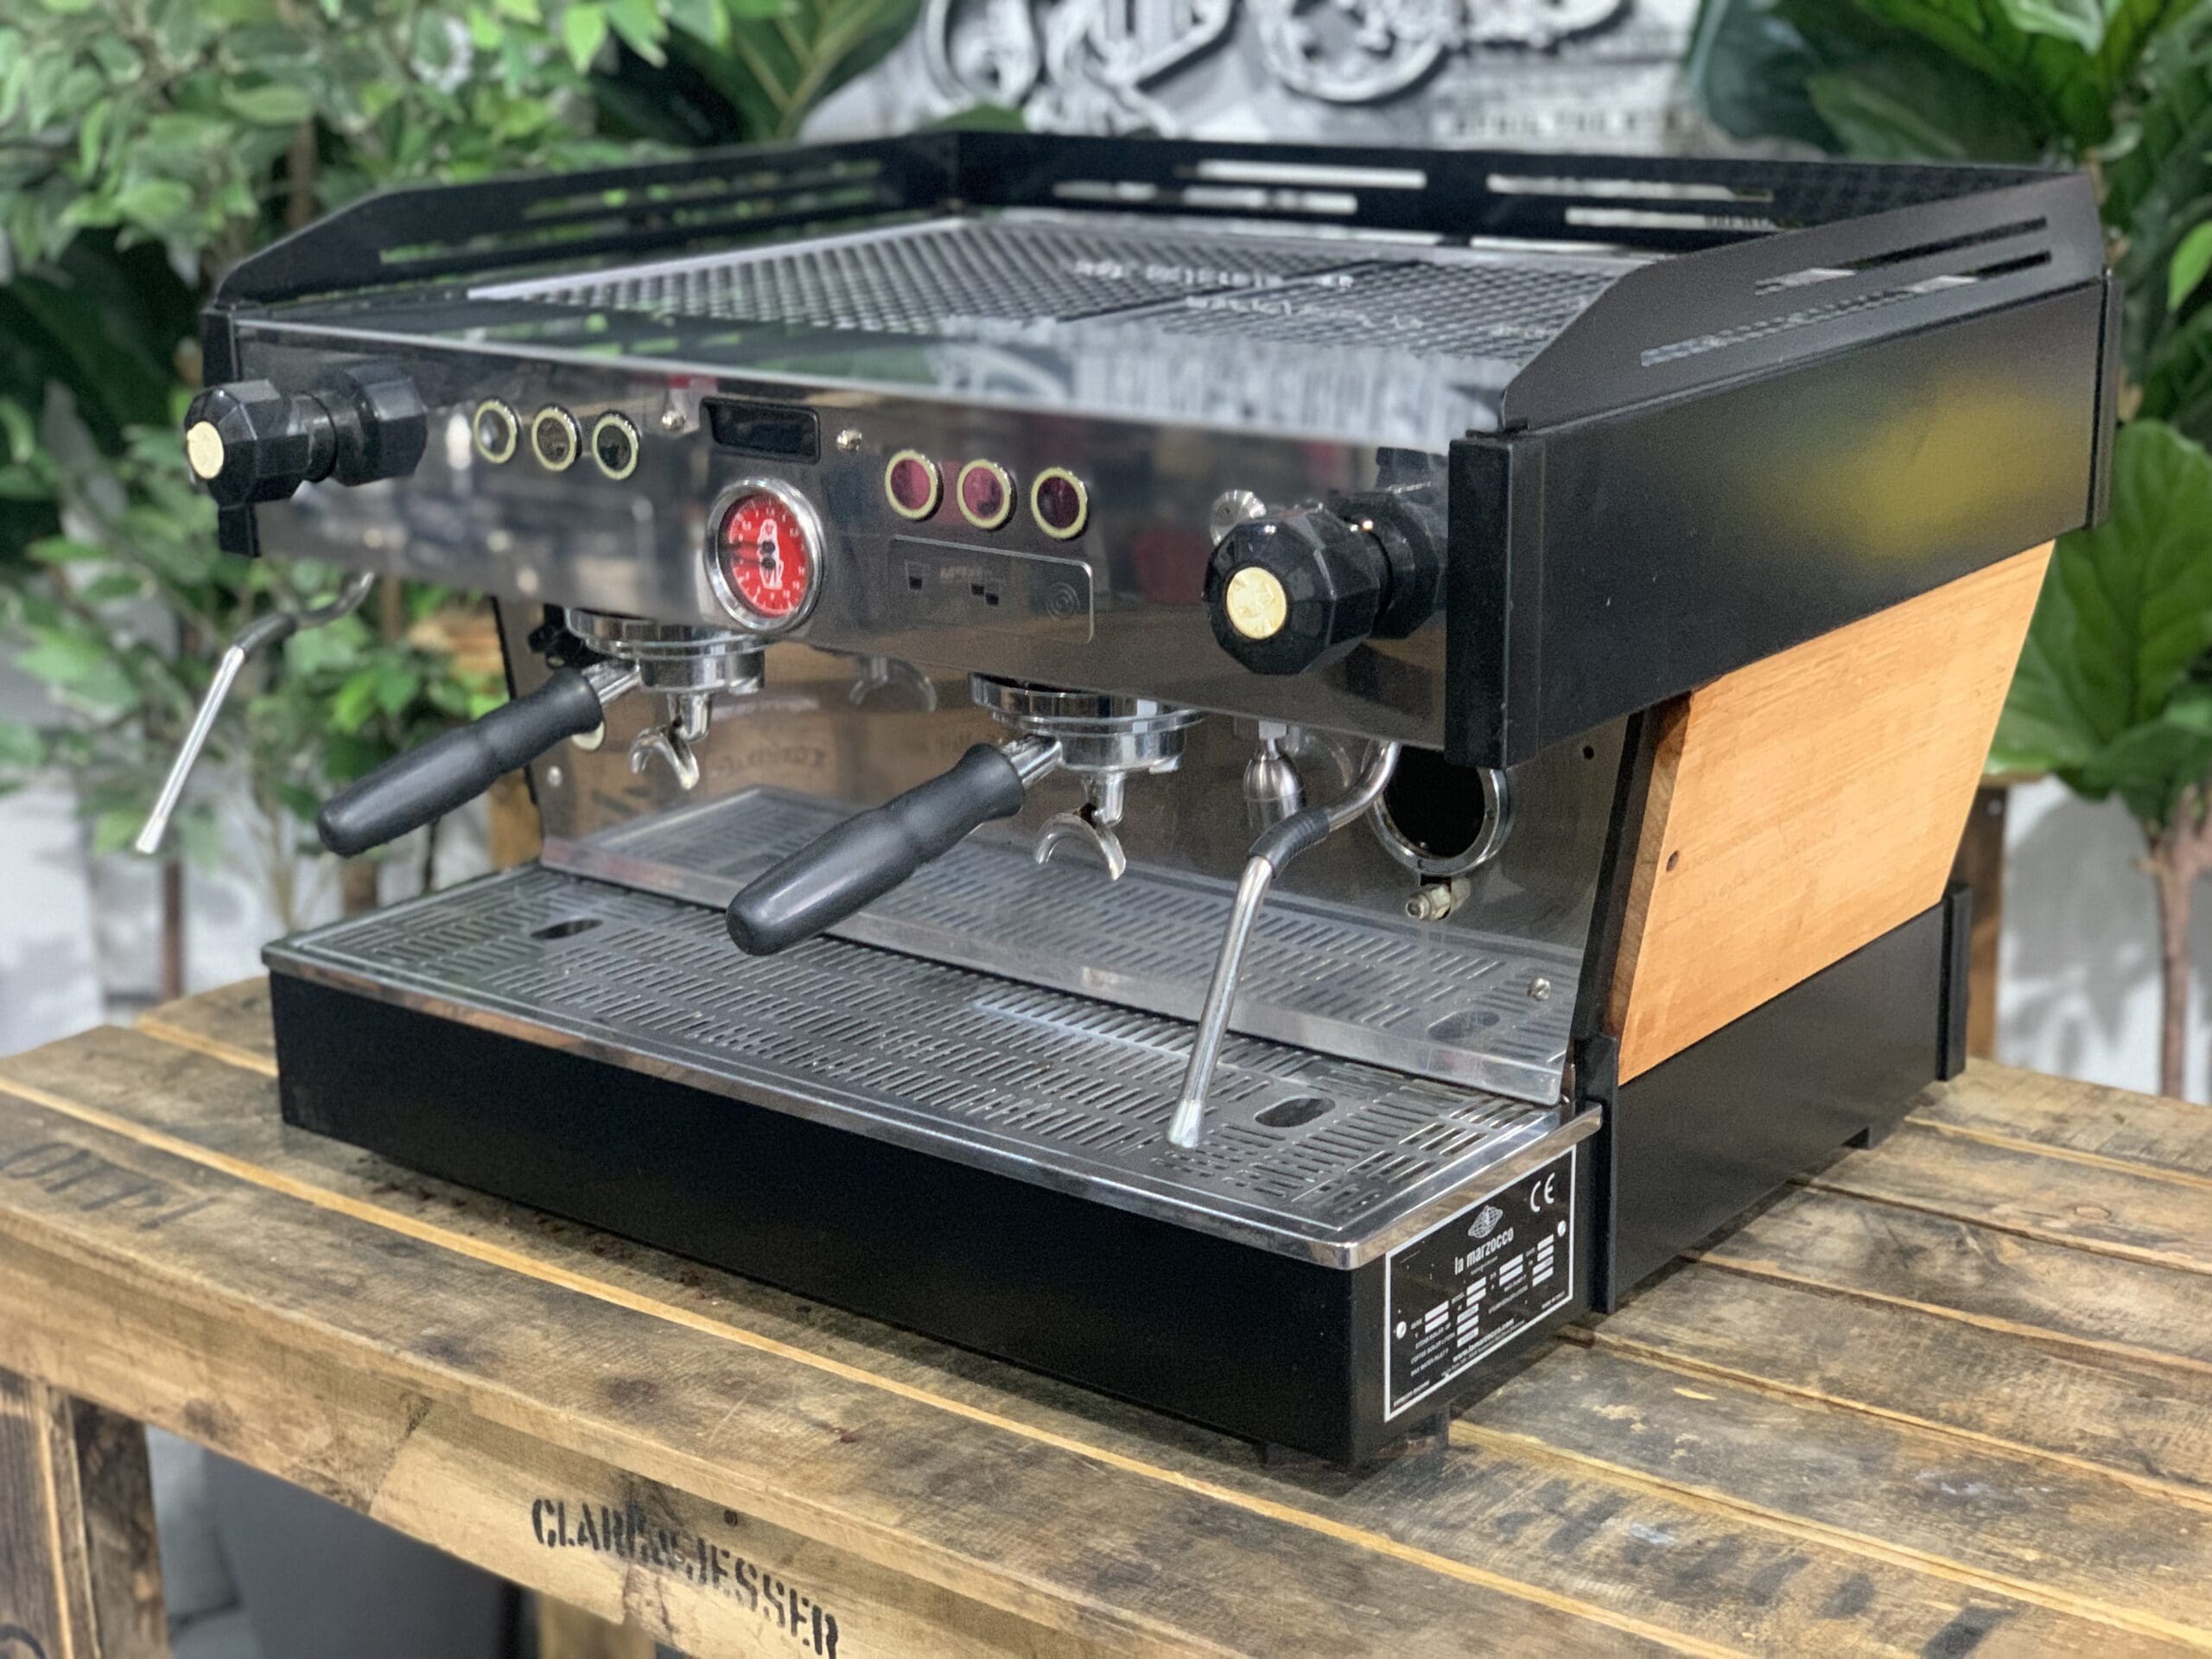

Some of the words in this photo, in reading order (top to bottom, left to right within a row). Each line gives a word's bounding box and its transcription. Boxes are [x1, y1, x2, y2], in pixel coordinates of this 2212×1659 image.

[1530, 1172, 1554, 1212] CE
[1454, 1255, 1465, 1275] la
[1466, 1227, 1514, 1268] marzocco
